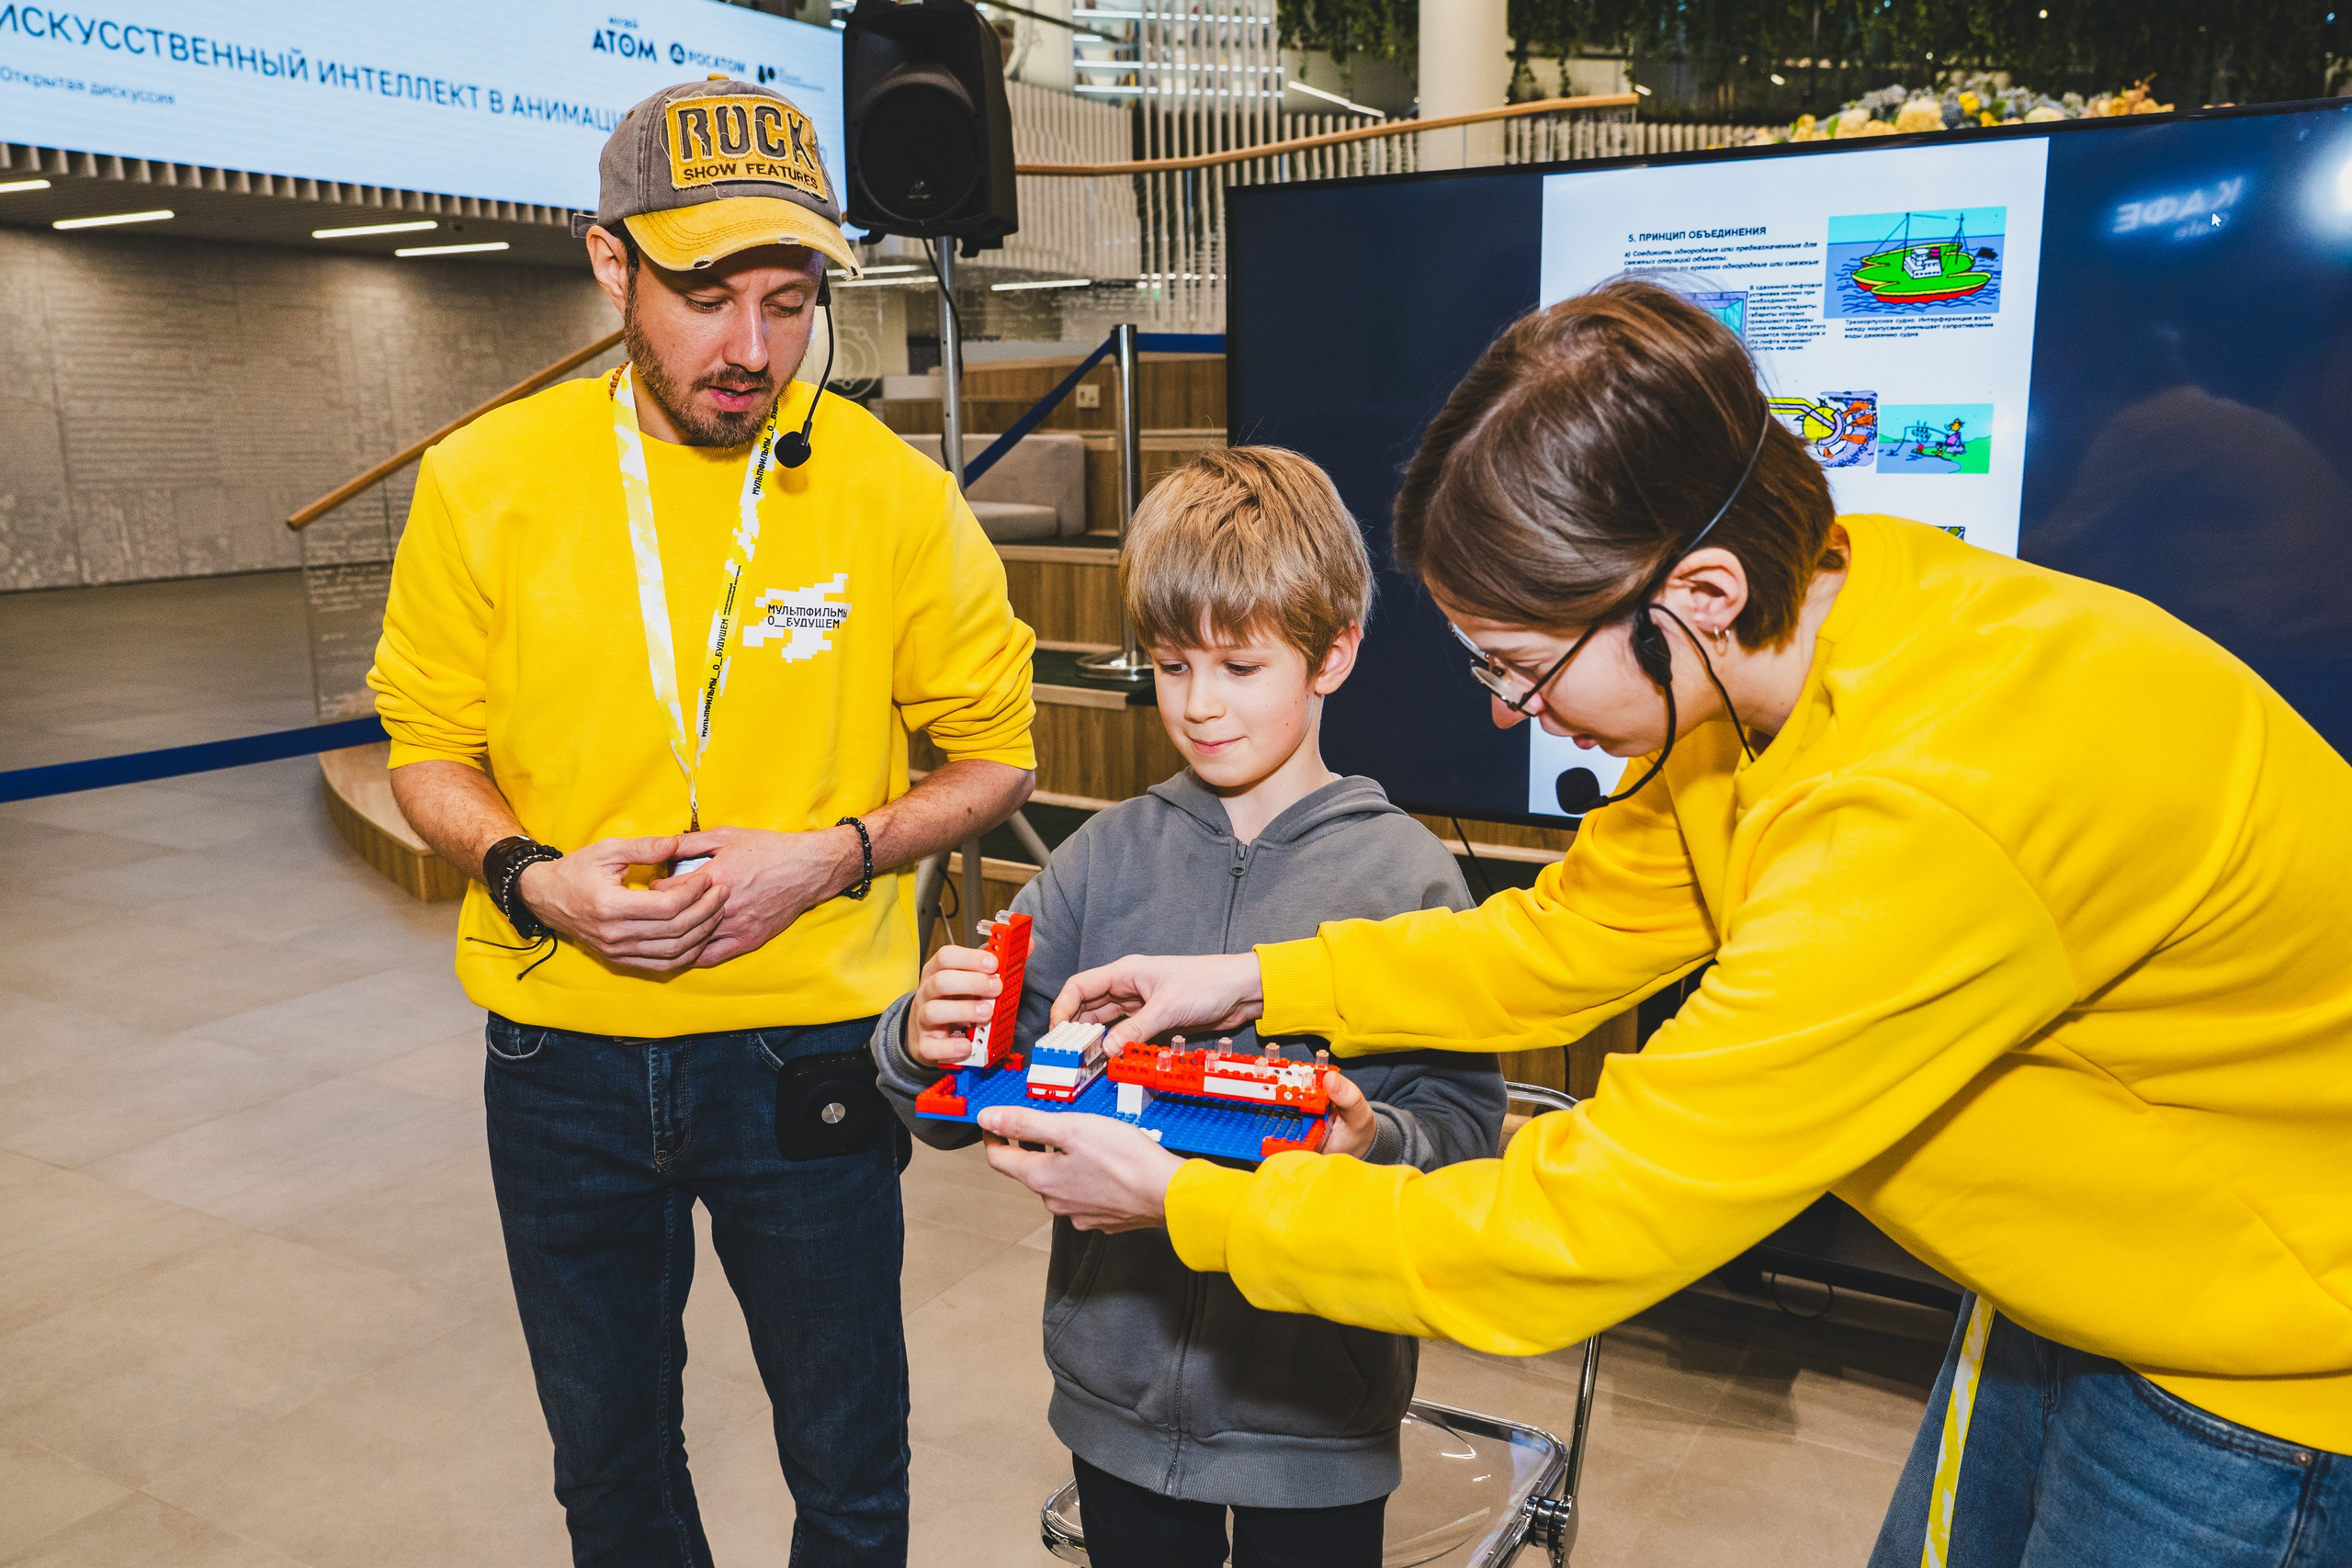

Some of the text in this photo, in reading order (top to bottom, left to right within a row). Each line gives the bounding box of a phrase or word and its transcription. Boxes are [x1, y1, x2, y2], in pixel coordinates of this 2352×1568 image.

[593, 29, 658, 62] АТОМ
[0, 4, 309, 82] ИСКУССТВЕННЫЙ
[317, 59, 481, 110] ИНТЕЛЛЕКТ
[489, 88, 504, 114] В
[687, 50, 747, 73] РОСАТОМ
[0, 65, 175, 104] Открытая дискуссия
[678, 105, 815, 171] ROCK
[684, 164, 819, 190] SHOW FEATURES
[1628, 226, 1767, 243] 5. ПРИНЦИП ОБЪЕДИНЕНИЯ
[1633, 249, 1672, 257] Соединить
[1674, 245, 1718, 255] однородные
[1736, 242, 1802, 253] предназначенные
[1804, 241, 1818, 249] для
[1624, 254, 1728, 266] смежных операций объекты.
[1690, 264, 1721, 274] времени
[1722, 260, 1768, 270] однородные
[1770, 260, 1783, 268] или
[1785, 258, 1820, 266] смежные
[1918, 314, 1973, 322] Интерференция
[1942, 321, 1994, 330] сопротивление
[767, 604, 847, 618] МУЛЬТФИЛЬМЫ
